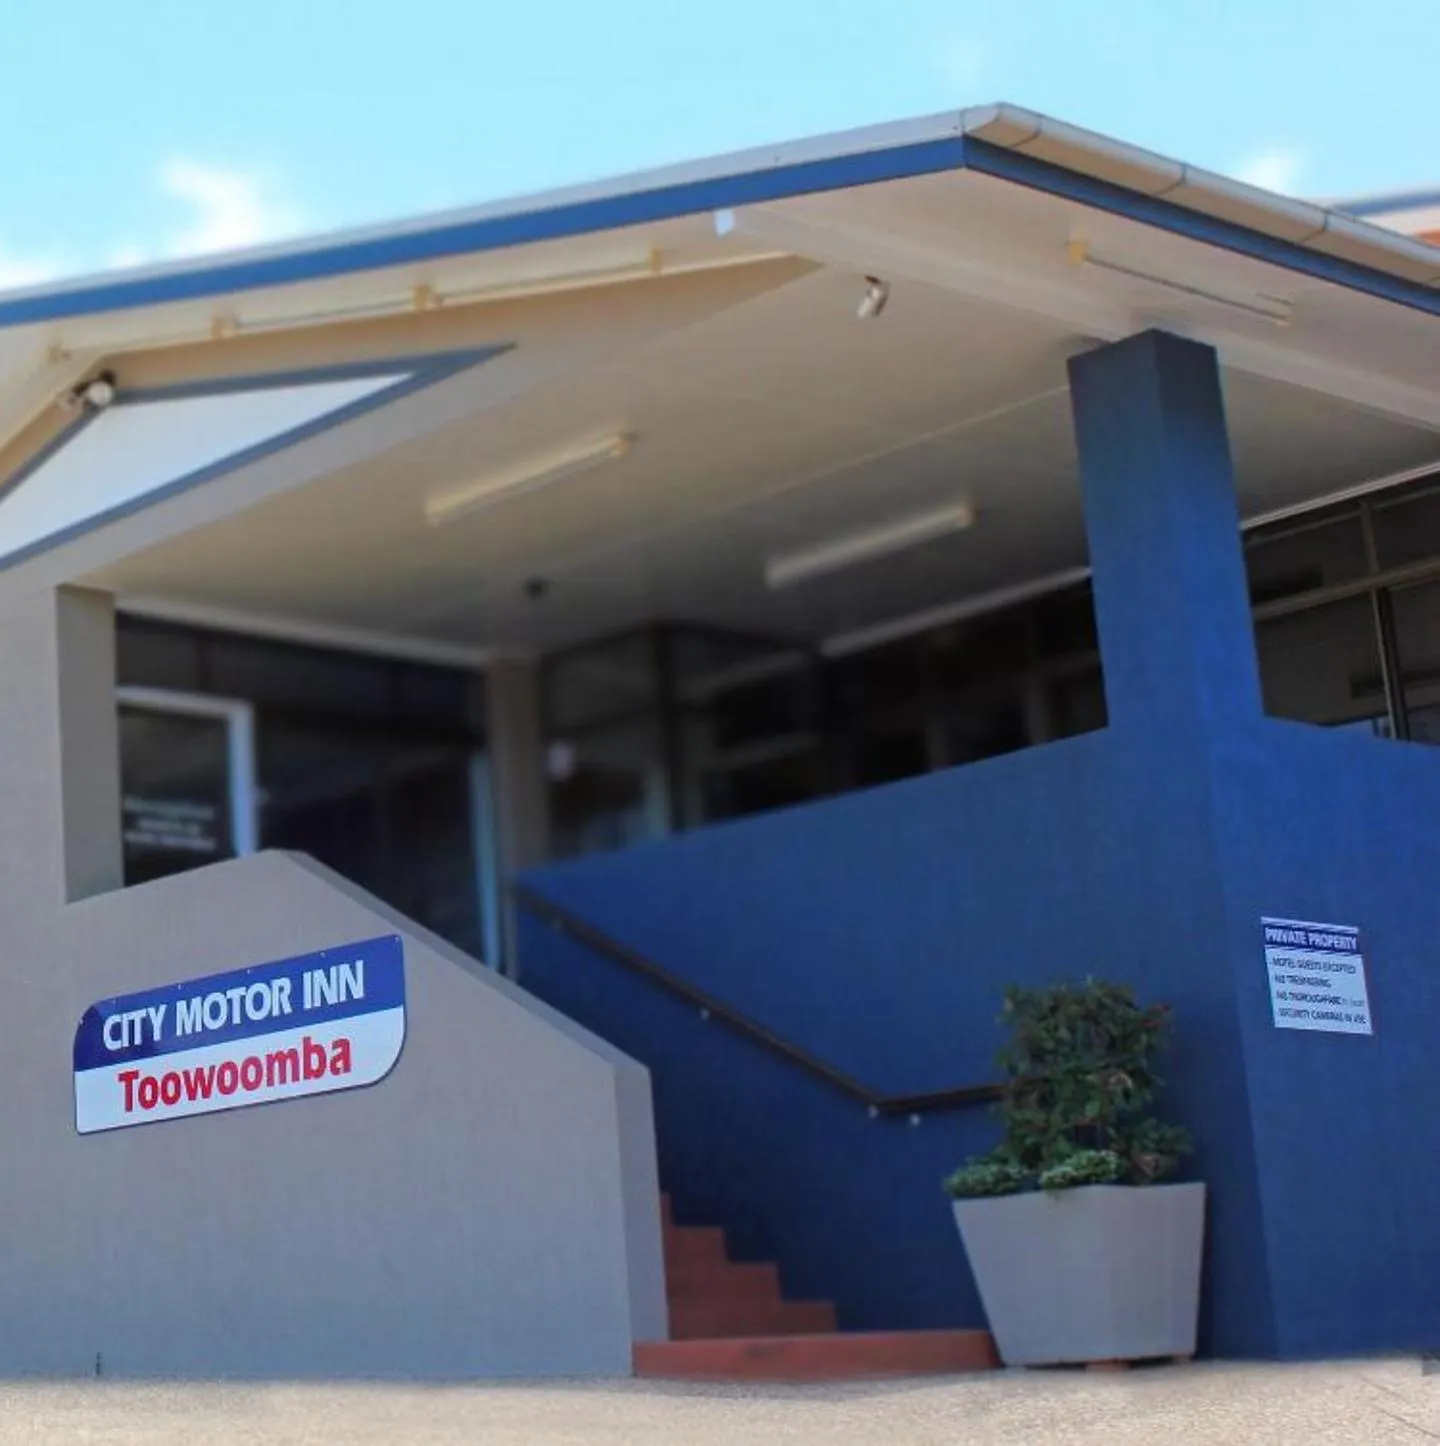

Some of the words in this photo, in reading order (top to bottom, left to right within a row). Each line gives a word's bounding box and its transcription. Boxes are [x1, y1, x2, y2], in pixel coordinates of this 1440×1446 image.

[1265, 927, 1306, 945] PRIVATE
[1308, 932, 1357, 950] PROPERTY
[103, 1003, 167, 1051] CITY
[176, 977, 292, 1036] MOTOR
[303, 960, 364, 1009] INN
[118, 1036, 351, 1113] Toowoomba
